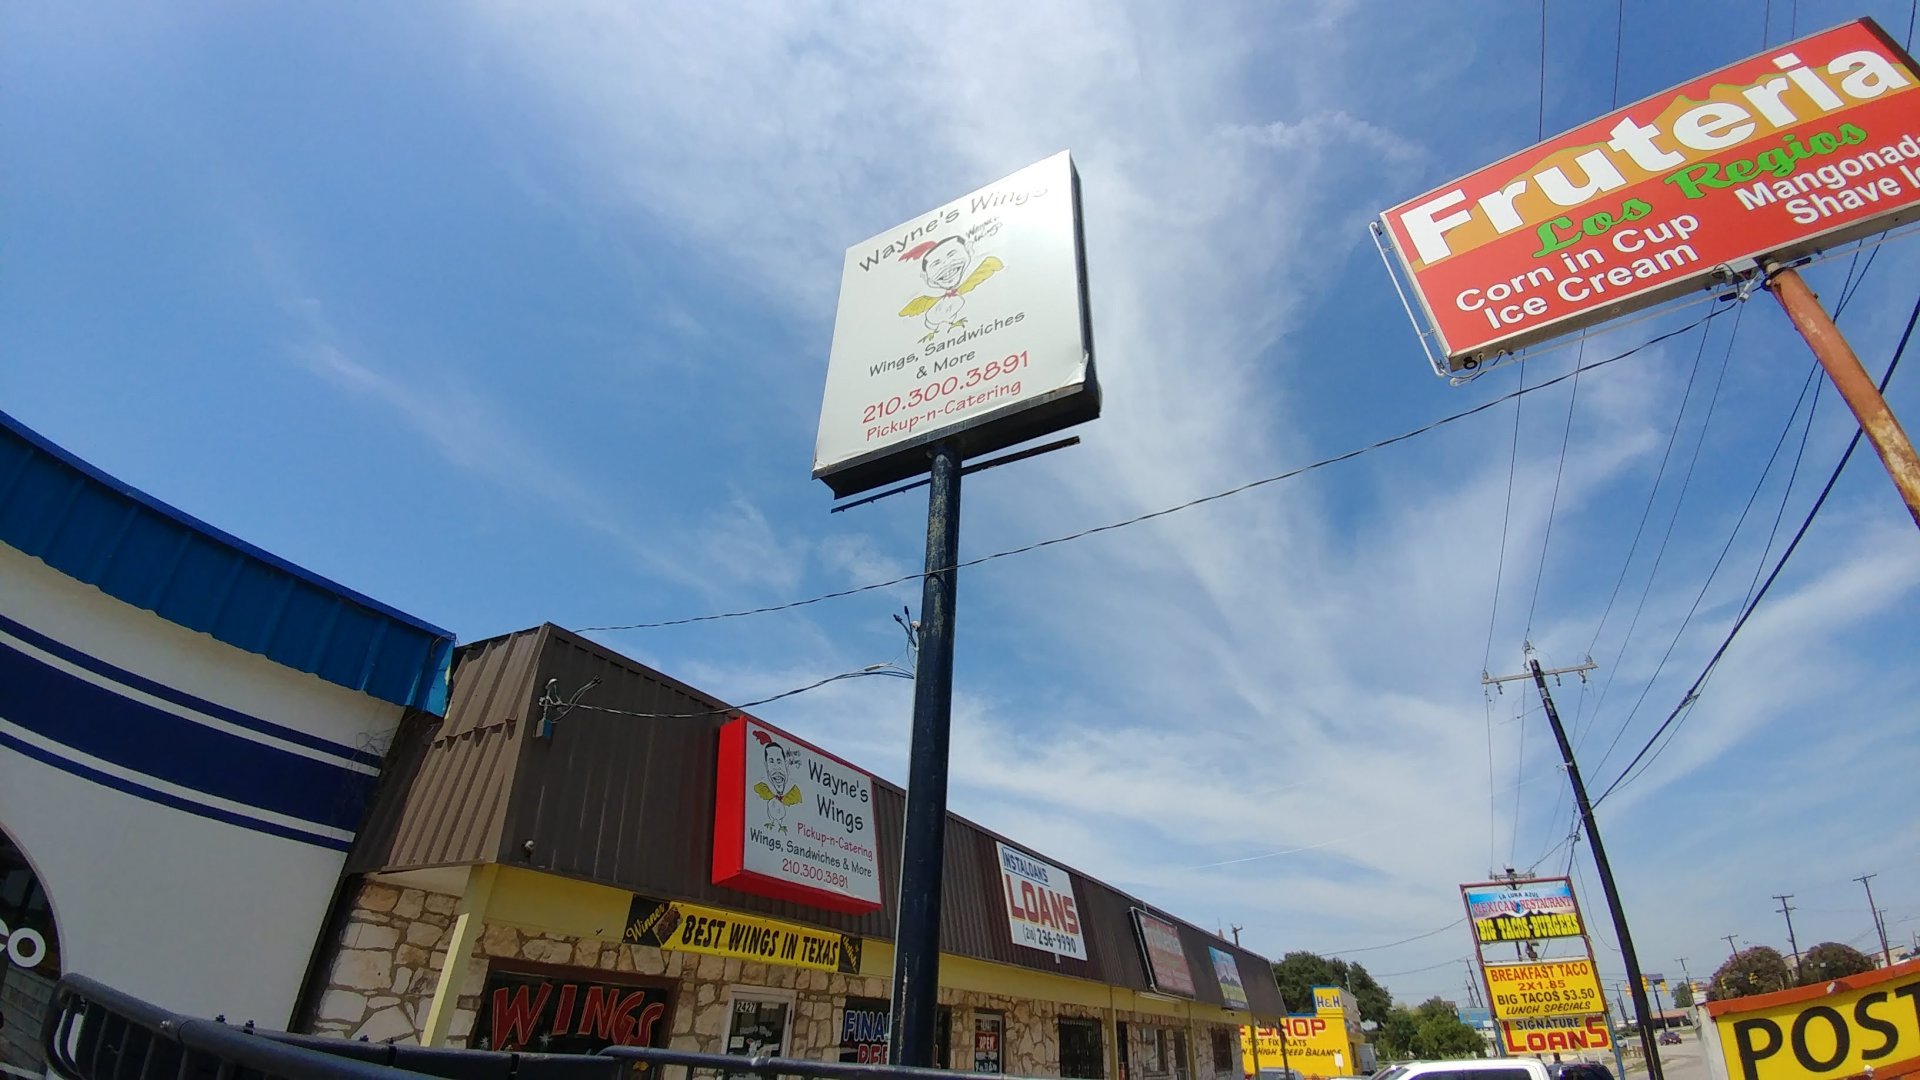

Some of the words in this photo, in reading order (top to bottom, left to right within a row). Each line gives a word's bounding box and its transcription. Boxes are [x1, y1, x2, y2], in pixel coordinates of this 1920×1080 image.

[1399, 49, 1911, 265] Fruteria
[1734, 133, 1920, 212] Mangonad
[1533, 198, 1652, 258] Los
[1664, 122, 1867, 199] Regios
[1785, 177, 1901, 224] Shave
[859, 209, 960, 273] Wayne's
[1455, 254, 1555, 312] Corn
[1562, 244, 1603, 272] in
[1611, 213, 1700, 255] Cup
[1484, 295, 1548, 330] Ice
[1557, 243, 1700, 303] Cream
[869, 353, 919, 378] Wings,
[924, 311, 1026, 357] Sandwiches
[916, 365, 928, 380] &
[933, 350, 976, 374] More
[862, 350, 1030, 424] 210.300.3891
[866, 381, 1022, 442] Pickup-n-Catering
[808, 758, 869, 803] Wayne's
[817, 794, 863, 833] Wings
[750, 827, 784, 853] Wings,
[787, 840, 840, 868] Sandwiches
[843, 858, 850, 870] &
[851, 861, 872, 878] More
[797, 822, 873, 861] Pickup-n-Catering
[782, 858, 849, 888] 210.300.3891
[626, 903, 665, 942] Winner
[1005, 874, 1079, 935] LOANS
[1472, 901, 1517, 913] MEXICAN
[1521, 896, 1572, 910] RESTAURANT
[1477, 919, 1497, 941] BIG
[1496, 917, 1531, 940] TACOS
[1530, 913, 1581, 938] BURGERS
[682, 914, 726, 947] BEST
[728, 923, 778, 957] WINGS
[780, 932, 798, 961] IN
[801, 936, 839, 966] TEXAS
[1490, 966, 1554, 982] BREAKFAST
[1558, 963, 1588, 977] TACO
[491, 982, 665, 1051] WINGS
[1316, 996, 1340, 1008] H&H
[1497, 994, 1517, 1005] BIG
[1520, 990, 1560, 1003] TACOS
[1563, 988, 1595, 1001] $3.50
[1506, 1004, 1540, 1015] LUNCH
[1543, 1001, 1591, 1013] SPECIALS
[1502, 1016, 1609, 1052] LOANS
[1516, 1018, 1581, 1030] SIGNATURE
